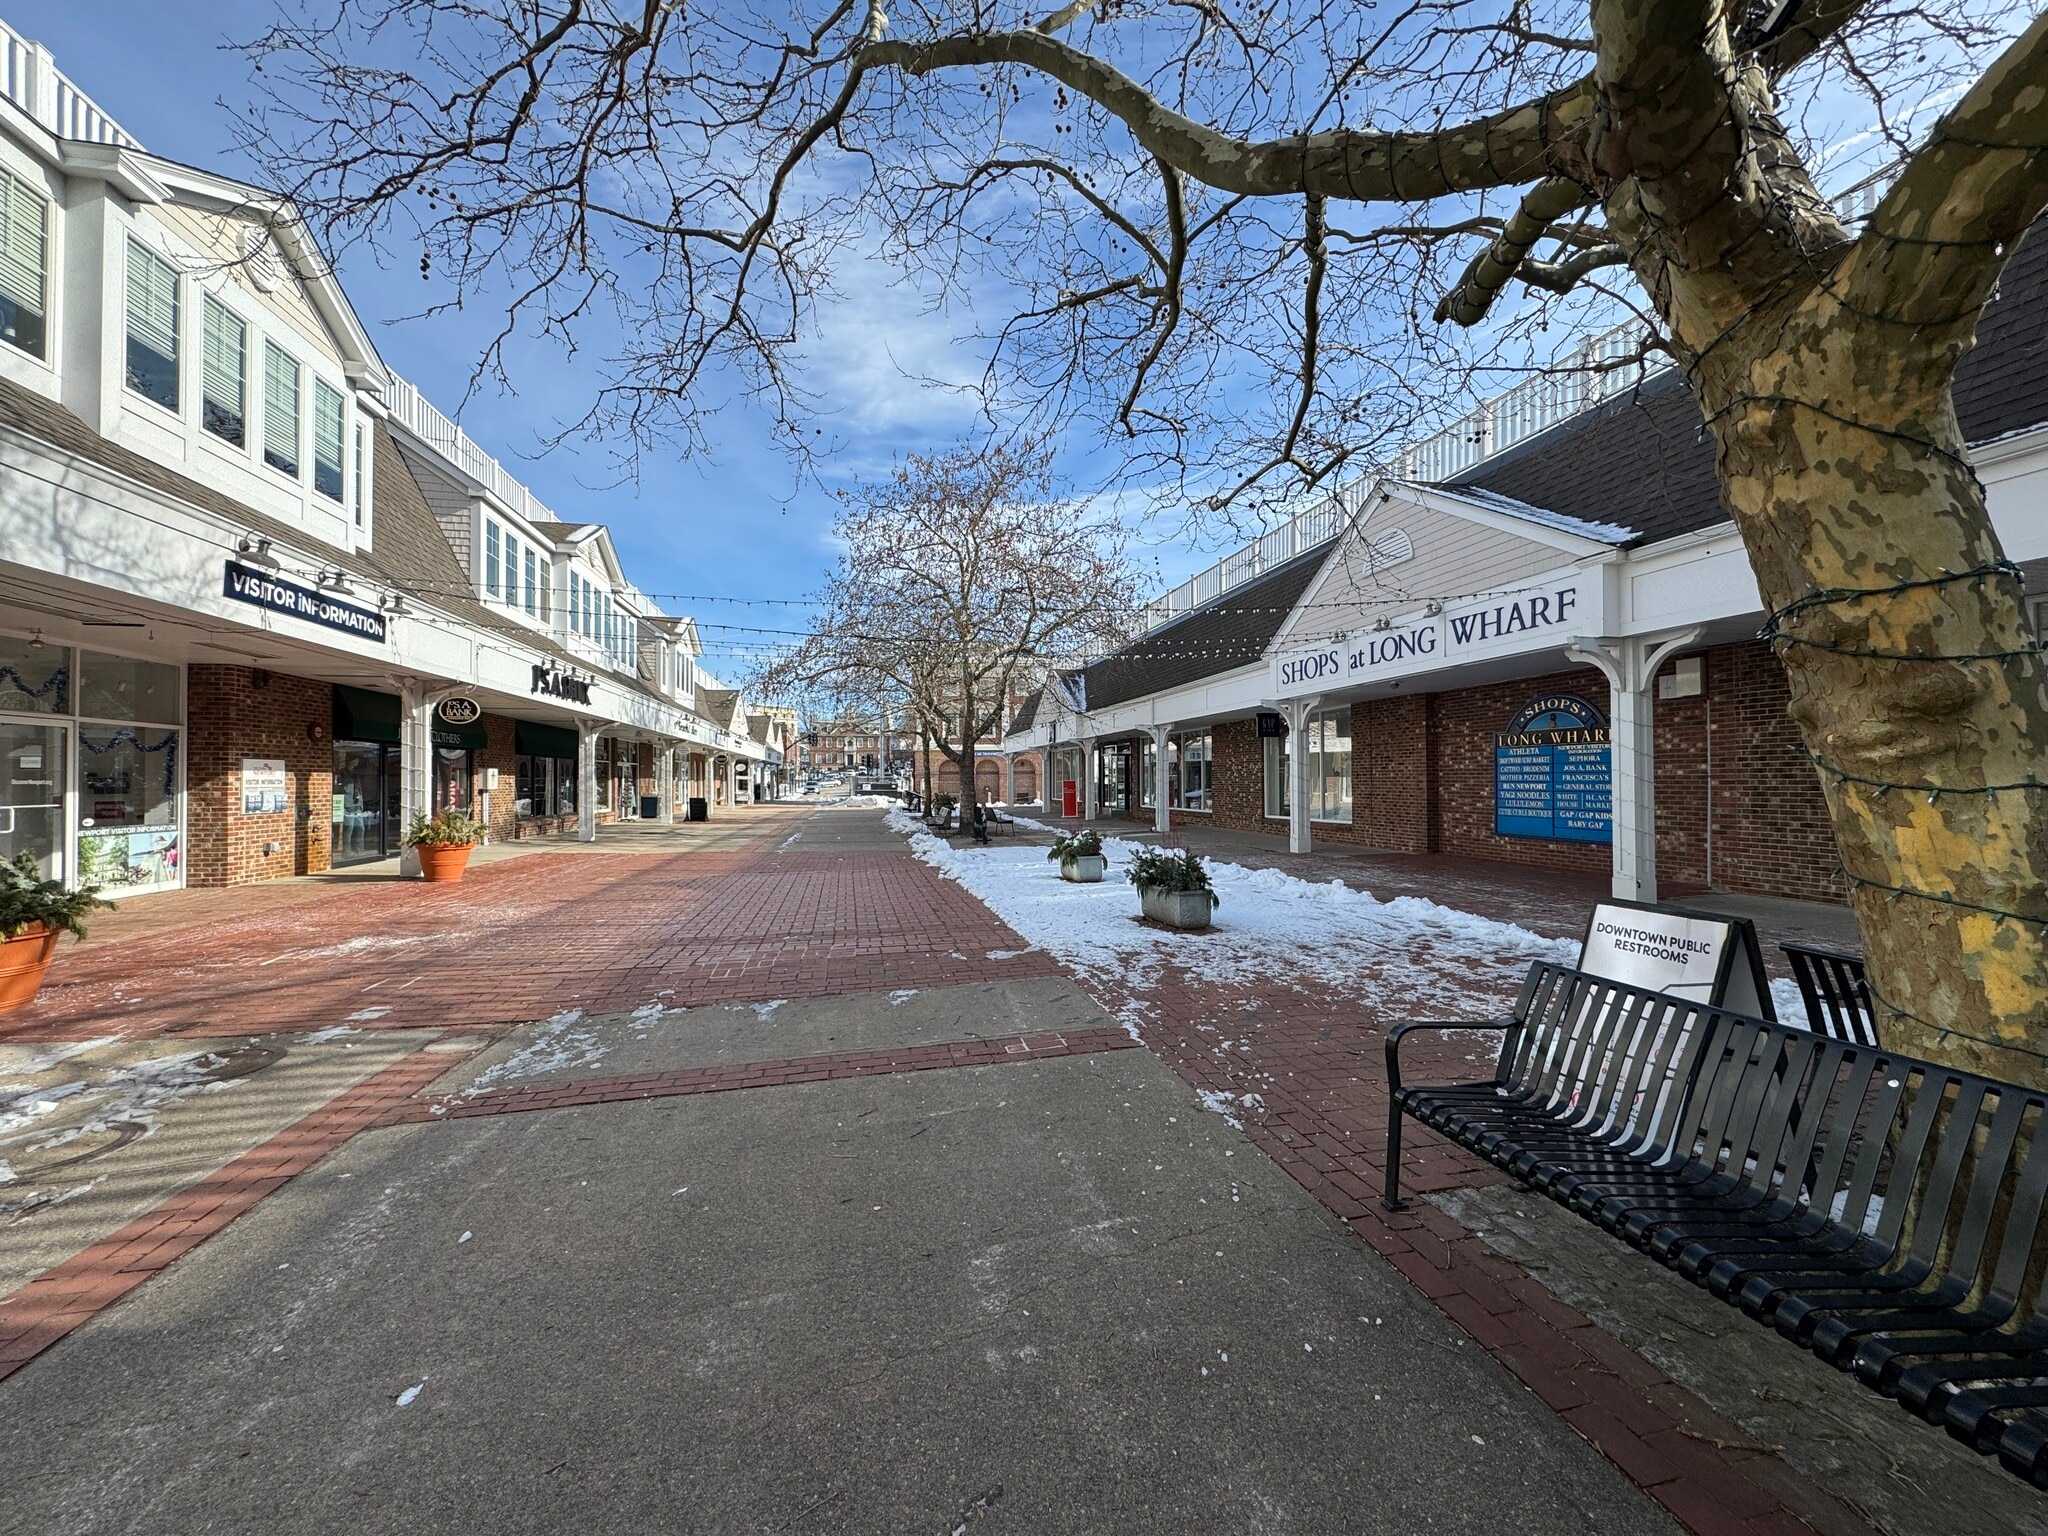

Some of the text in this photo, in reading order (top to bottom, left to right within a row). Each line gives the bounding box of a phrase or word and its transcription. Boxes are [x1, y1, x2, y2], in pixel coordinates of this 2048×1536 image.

[232, 572, 295, 609] VISITOR
[1281, 588, 1577, 685] SHOPS at LONG WHARF
[446, 708, 473, 716] BANK
[1525, 699, 1581, 719] SHOPS
[1499, 733, 1543, 747] LONG
[1509, 747, 1540, 756] ATHLETA
[1517, 792, 1550, 800] NOODLES
[1527, 810, 1552, 818] BOUTIQUE
[1595, 812, 1613, 820] KIDS
[77, 825, 177, 837] NEWPORT VISITOR INFORMATION
[1588, 821, 1604, 829] GAP
[1597, 922, 1711, 955] DOWNTOWN PUBLIC
[1614, 939, 1689, 964] RESTROOMS
